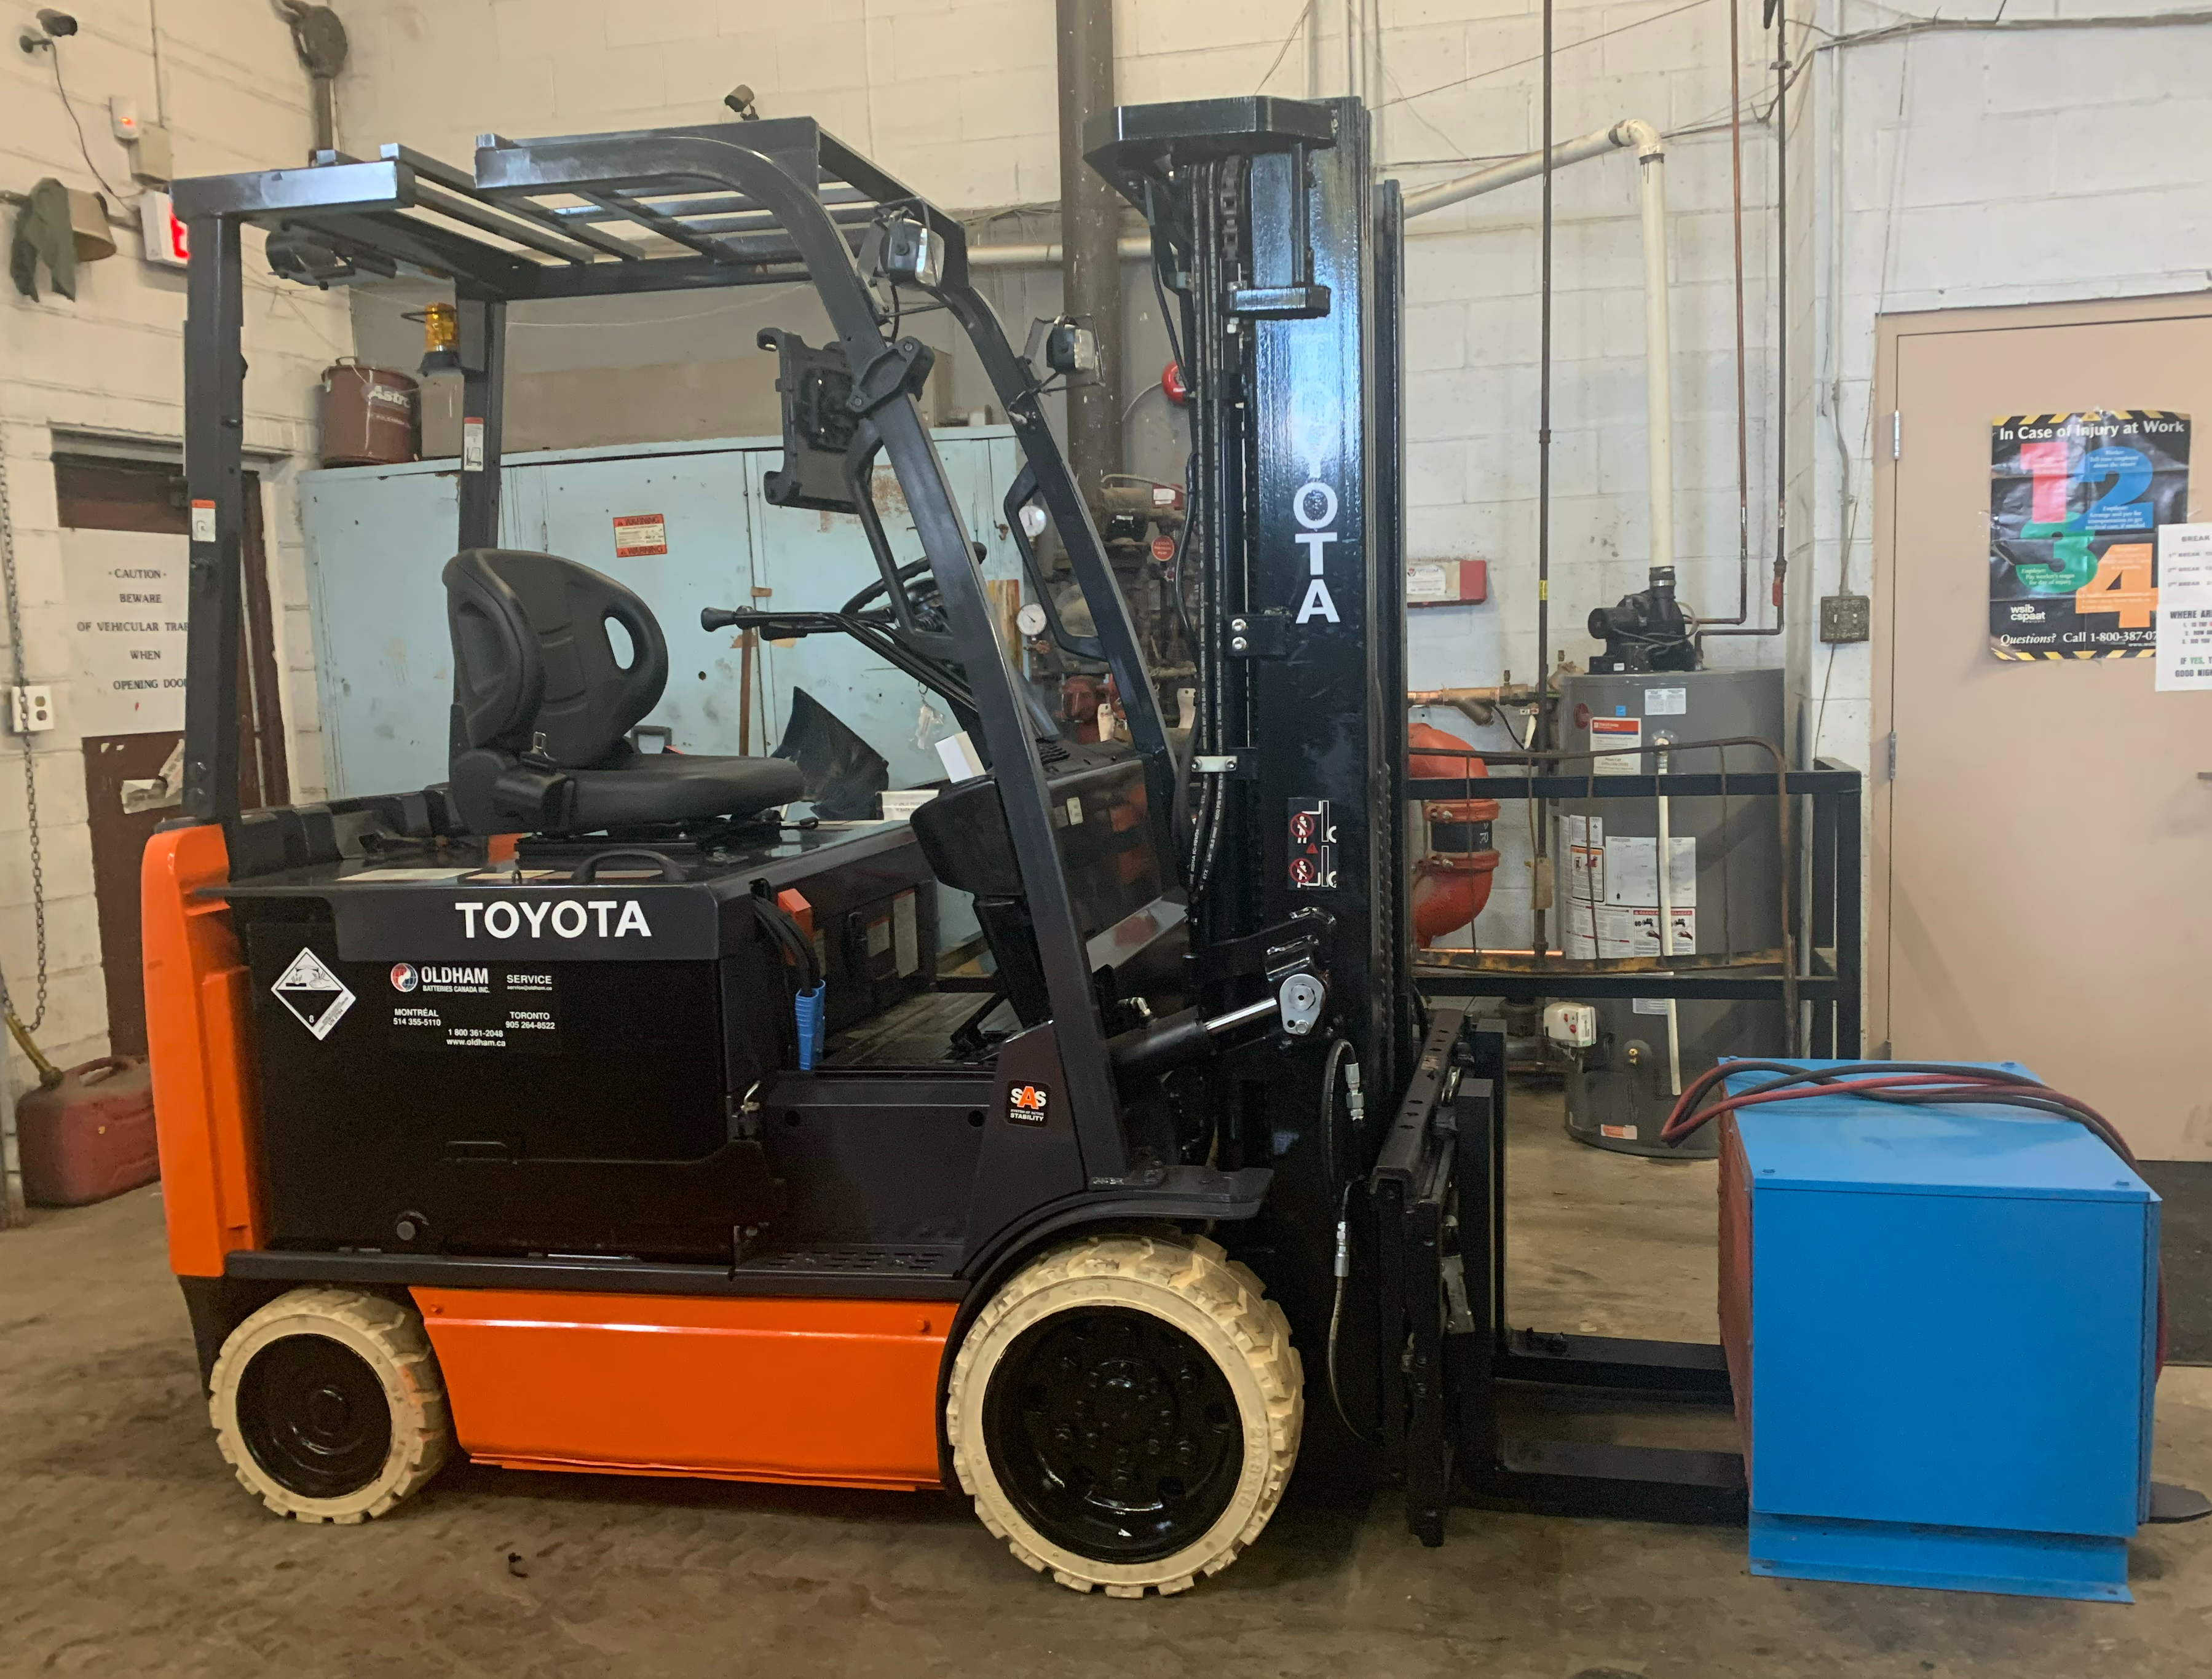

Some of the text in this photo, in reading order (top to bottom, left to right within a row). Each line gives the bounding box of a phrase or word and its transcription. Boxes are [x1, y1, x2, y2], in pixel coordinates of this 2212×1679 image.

[2000, 421, 2185, 440] In Case of Injury at Work
[2021, 441, 2068, 523] 1
[2066, 446, 2153, 531] 2
[2015, 511, 2098, 593] 3
[114, 569, 161, 579] CAUTION
[2076, 543, 2159, 628] 4
[119, 593, 162, 603] BEWARE
[2010, 604, 2035, 614] wsib
[2010, 611, 2046, 623] cspaat
[2170, 610, 2197, 619] WHERE
[77, 622, 92, 631] OF
[97, 622, 159, 631] VEHICULAR
[2000, 631, 2157, 646] Questions? Call 1-800-387-07
[130, 650, 161, 660] WHEN
[113, 679, 158, 690] OPENING
[455, 900, 652, 939] TOYOTA
[421, 966, 489, 984] OLDHAM
[507, 974, 552, 984] SERVICE
[395, 1008, 439, 1017] MONTRÉAL
[510, 1011, 550, 1020] TORONTO
[309, 1014, 314, 1023] 8
[521, 1021, 555, 1030] 264-8522
[469, 1029, 504, 1038] 361-2048
[446, 1038, 506, 1047] www.oldham.ca
[1010, 1086, 1046, 1110] SAS
[1010, 1112, 1044, 1122] STABILITY
